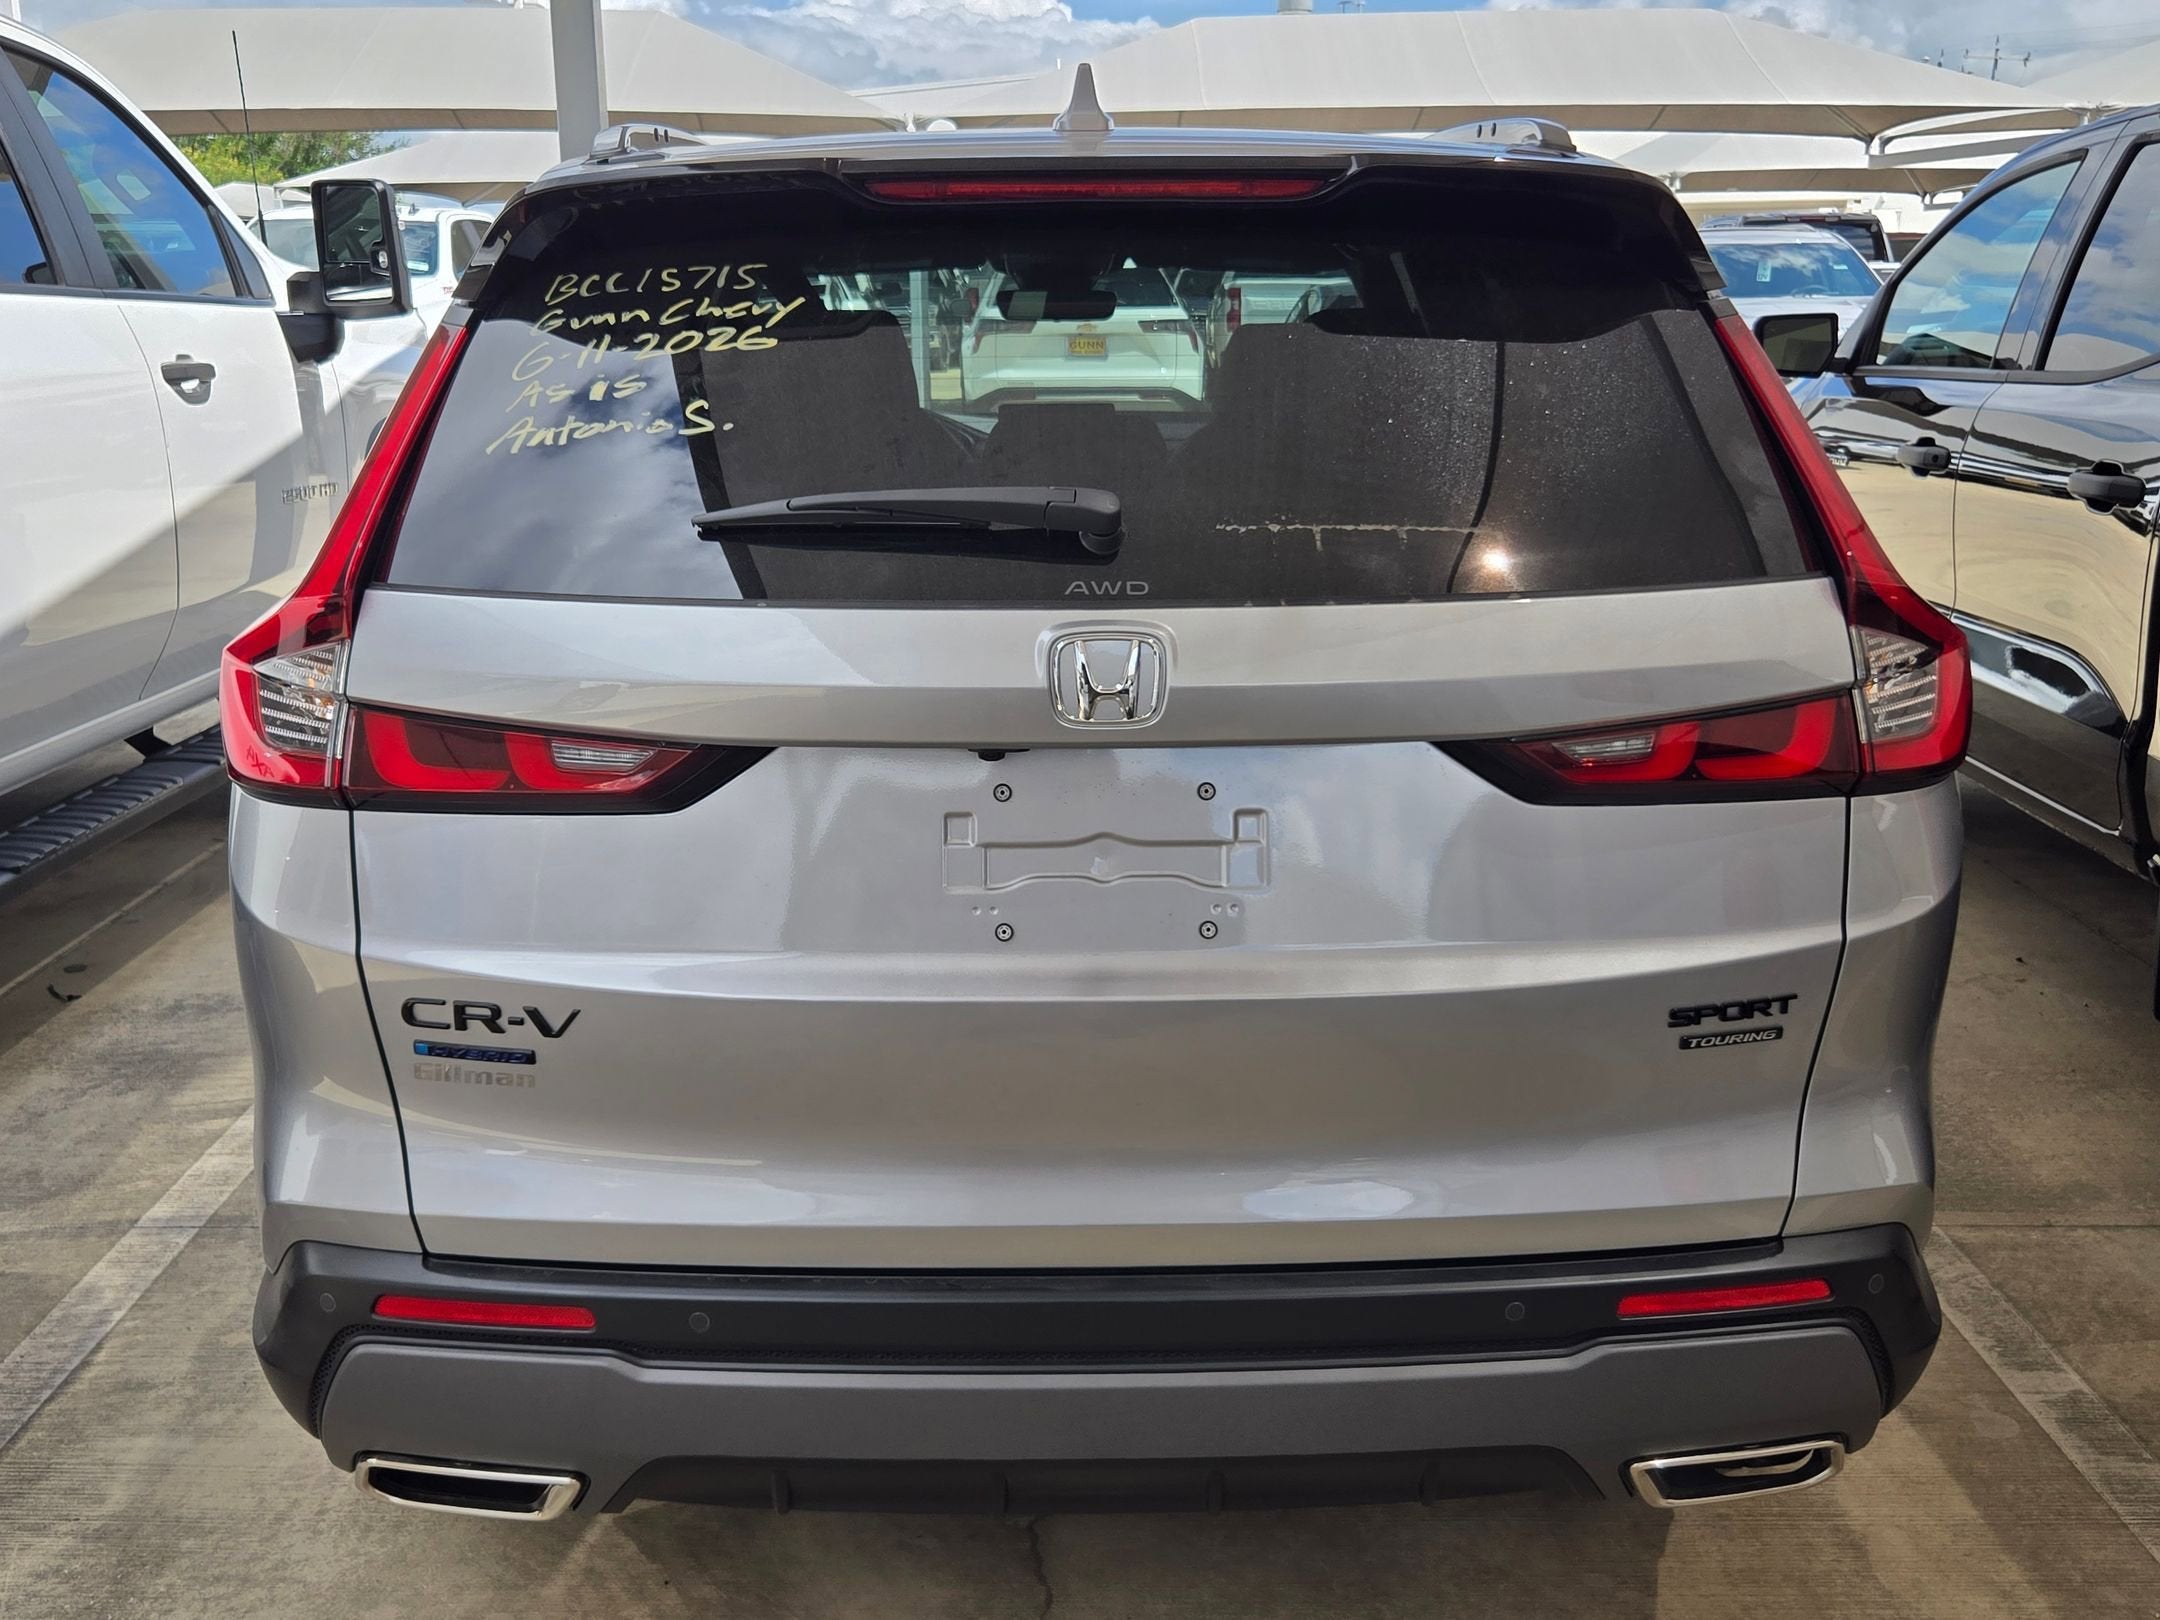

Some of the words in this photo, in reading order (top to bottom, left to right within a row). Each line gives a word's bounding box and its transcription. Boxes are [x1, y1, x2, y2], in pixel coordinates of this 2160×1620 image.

[1069, 340, 1105, 350] GUNN
[1064, 580, 1150, 596] AWD
[400, 997, 582, 1038] CR-V
[1667, 993, 1799, 1029] SPORT
[1688, 1029, 1778, 1048] TOURING
[414, 1062, 536, 1089] Gillman
